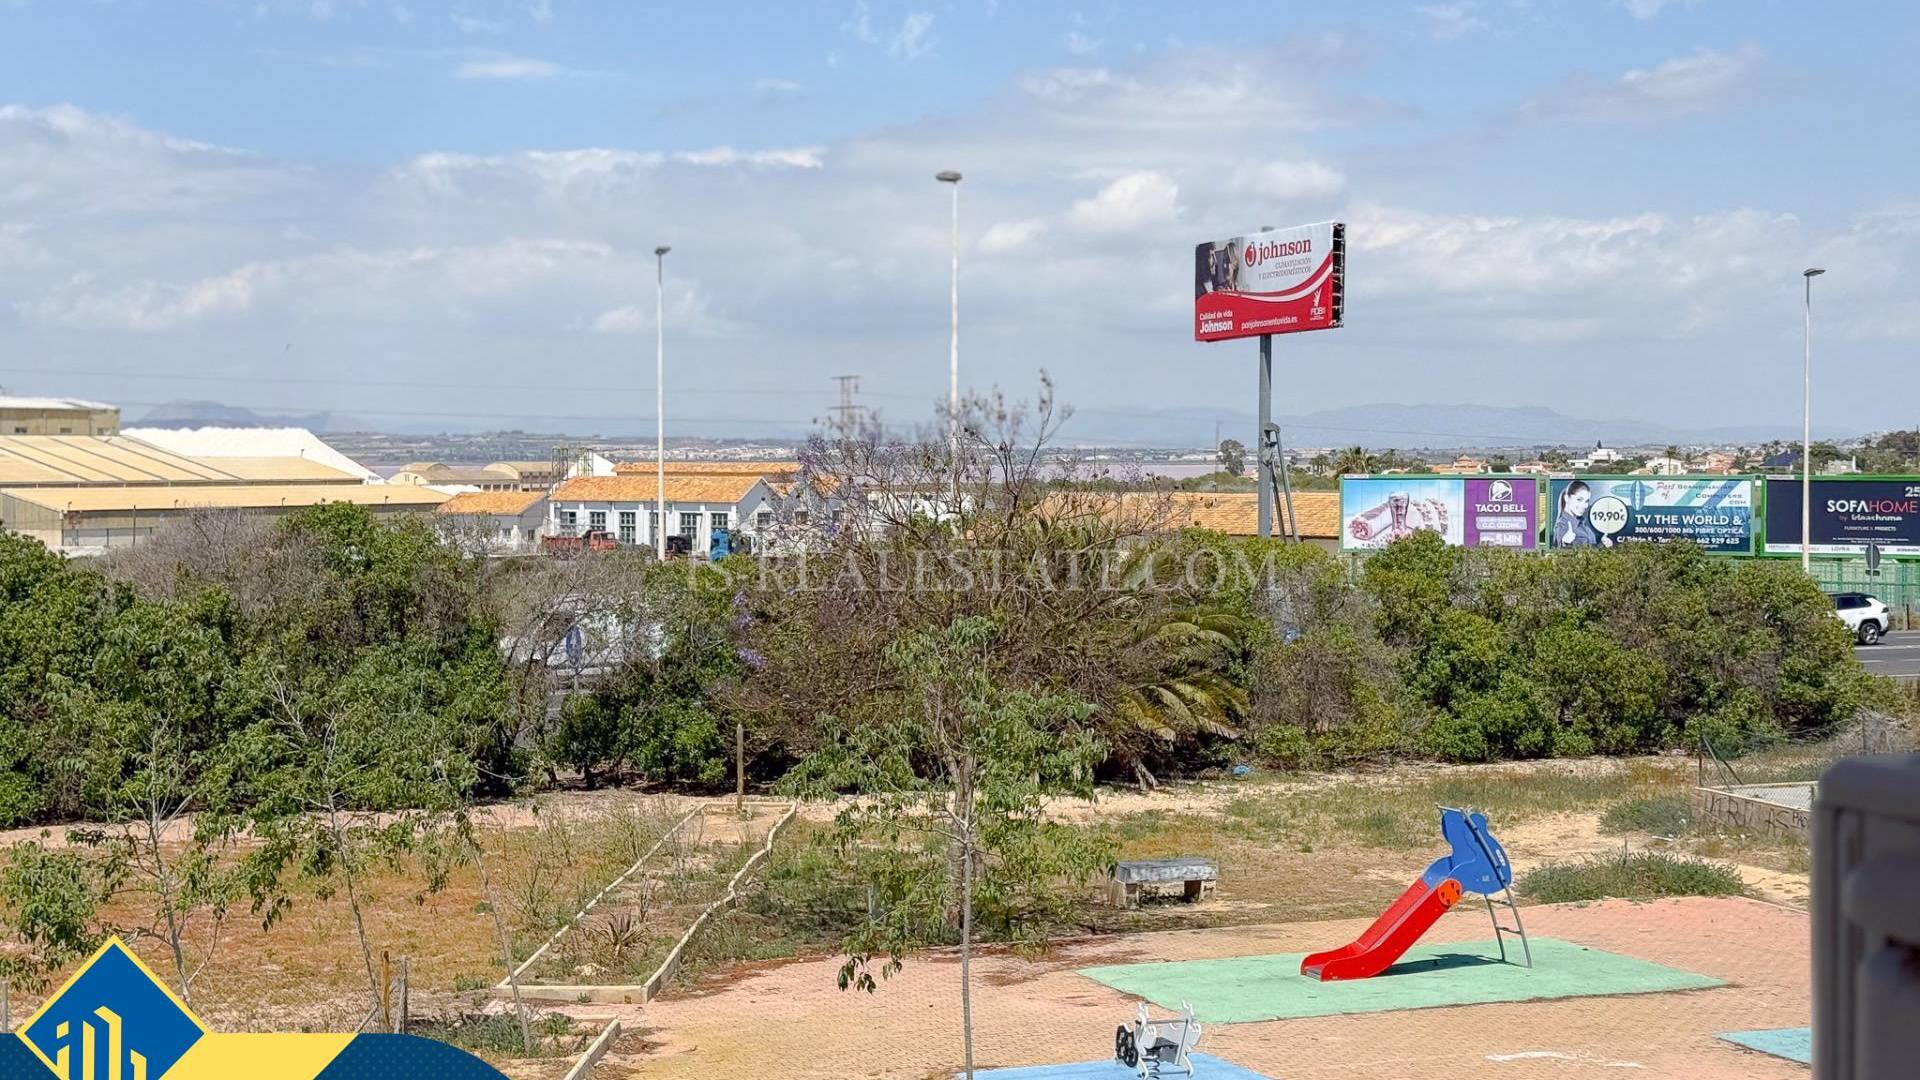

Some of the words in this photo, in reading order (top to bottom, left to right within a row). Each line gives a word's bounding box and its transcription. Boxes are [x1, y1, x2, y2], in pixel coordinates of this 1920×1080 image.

[1257, 239, 1312, 266] johnson
[1199, 320, 1233, 334] Johnson
[1475, 503, 1502, 513] TACO
[1502, 503, 1527, 513] BELL
[1635, 514, 1651, 525] TV
[1654, 514, 1679, 525] THE
[1682, 514, 1729, 525] WORLD
[1732, 515, 1743, 526] &
[1696, 537, 1710, 545] 662
[1710, 537, 1725, 545] 929
